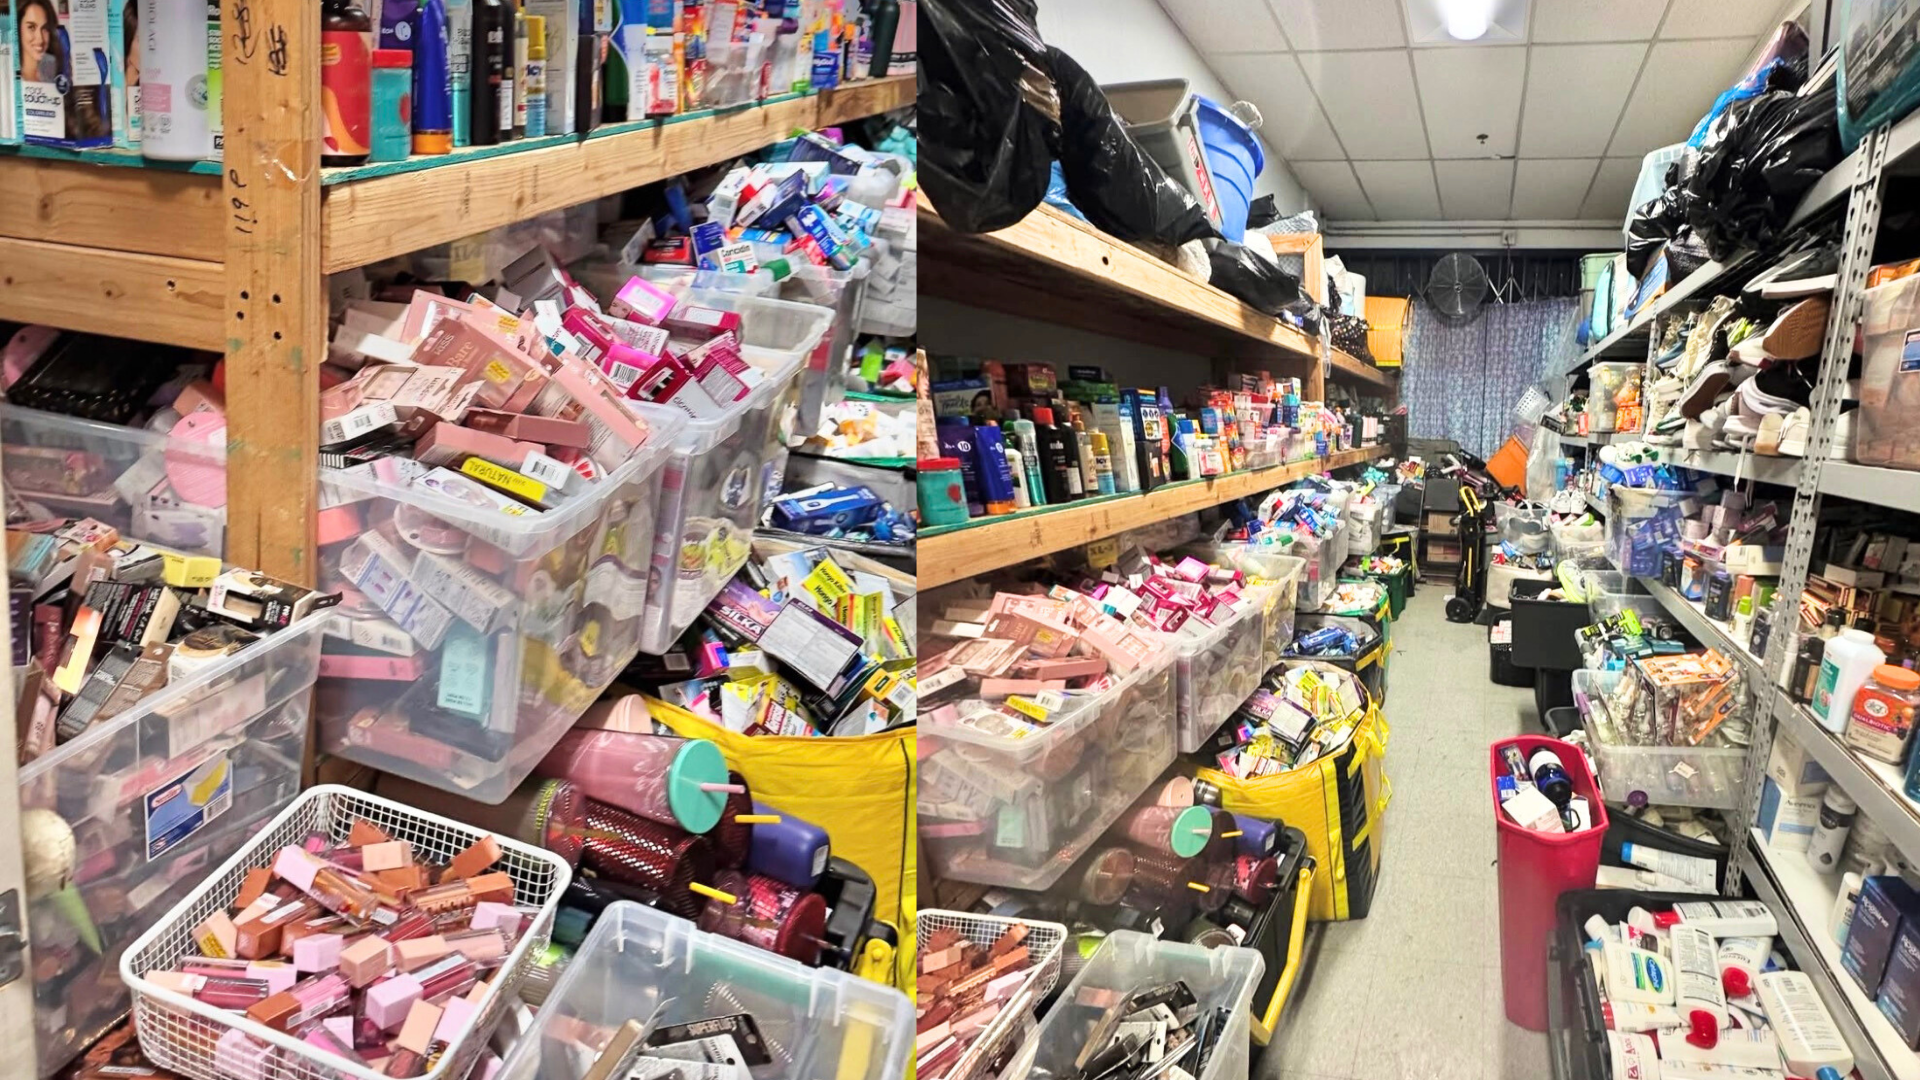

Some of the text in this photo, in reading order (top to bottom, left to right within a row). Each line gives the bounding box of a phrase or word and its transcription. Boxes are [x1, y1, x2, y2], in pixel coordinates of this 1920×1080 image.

[468, 460, 512, 485] NATURAL
[815, 584, 833, 606] Hongo
[720, 605, 762, 635] SILKA
[1251, 705, 1272, 717] SILKA
[1862, 895, 1889, 928] Rogaine
